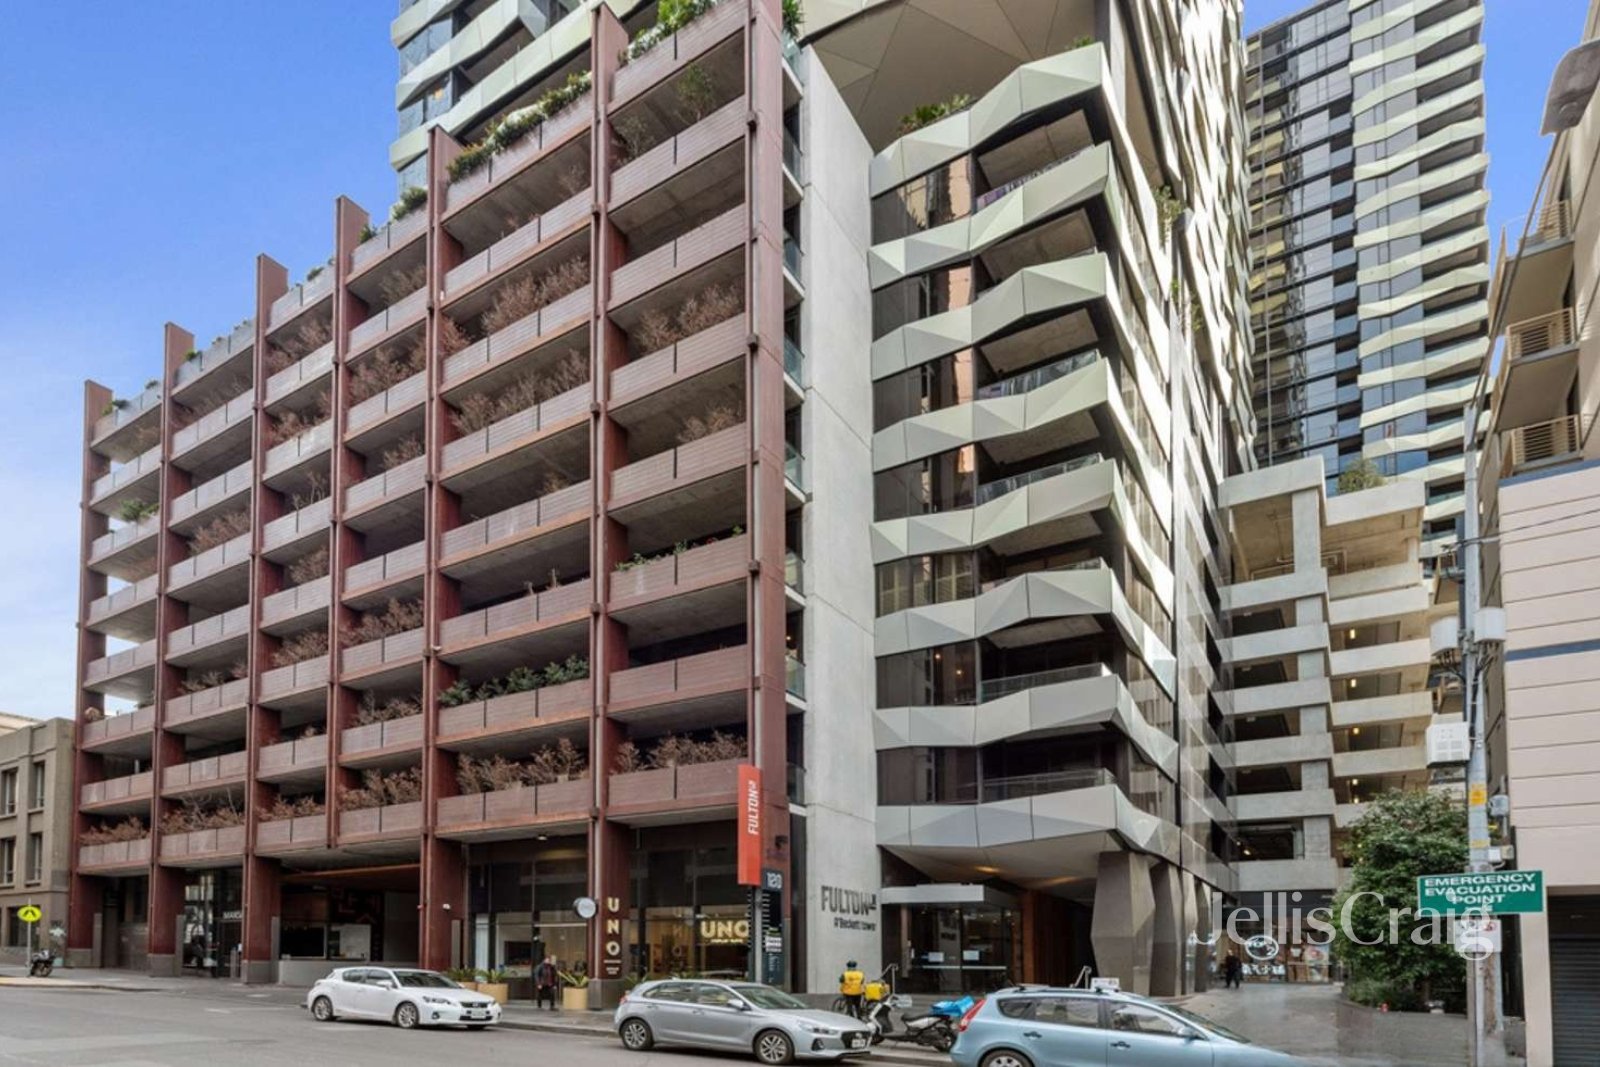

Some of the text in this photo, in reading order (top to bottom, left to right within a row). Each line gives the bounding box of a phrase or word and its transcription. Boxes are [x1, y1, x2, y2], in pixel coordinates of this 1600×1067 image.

[1424, 873, 1536, 887] EMERGENCY
[1424, 883, 1536, 896] EVACUATION
[821, 885, 869, 916] FULTON
[1450, 894, 1506, 904] POINT
[606, 897, 620, 956] UNO
[701, 920, 749, 938] UNO
